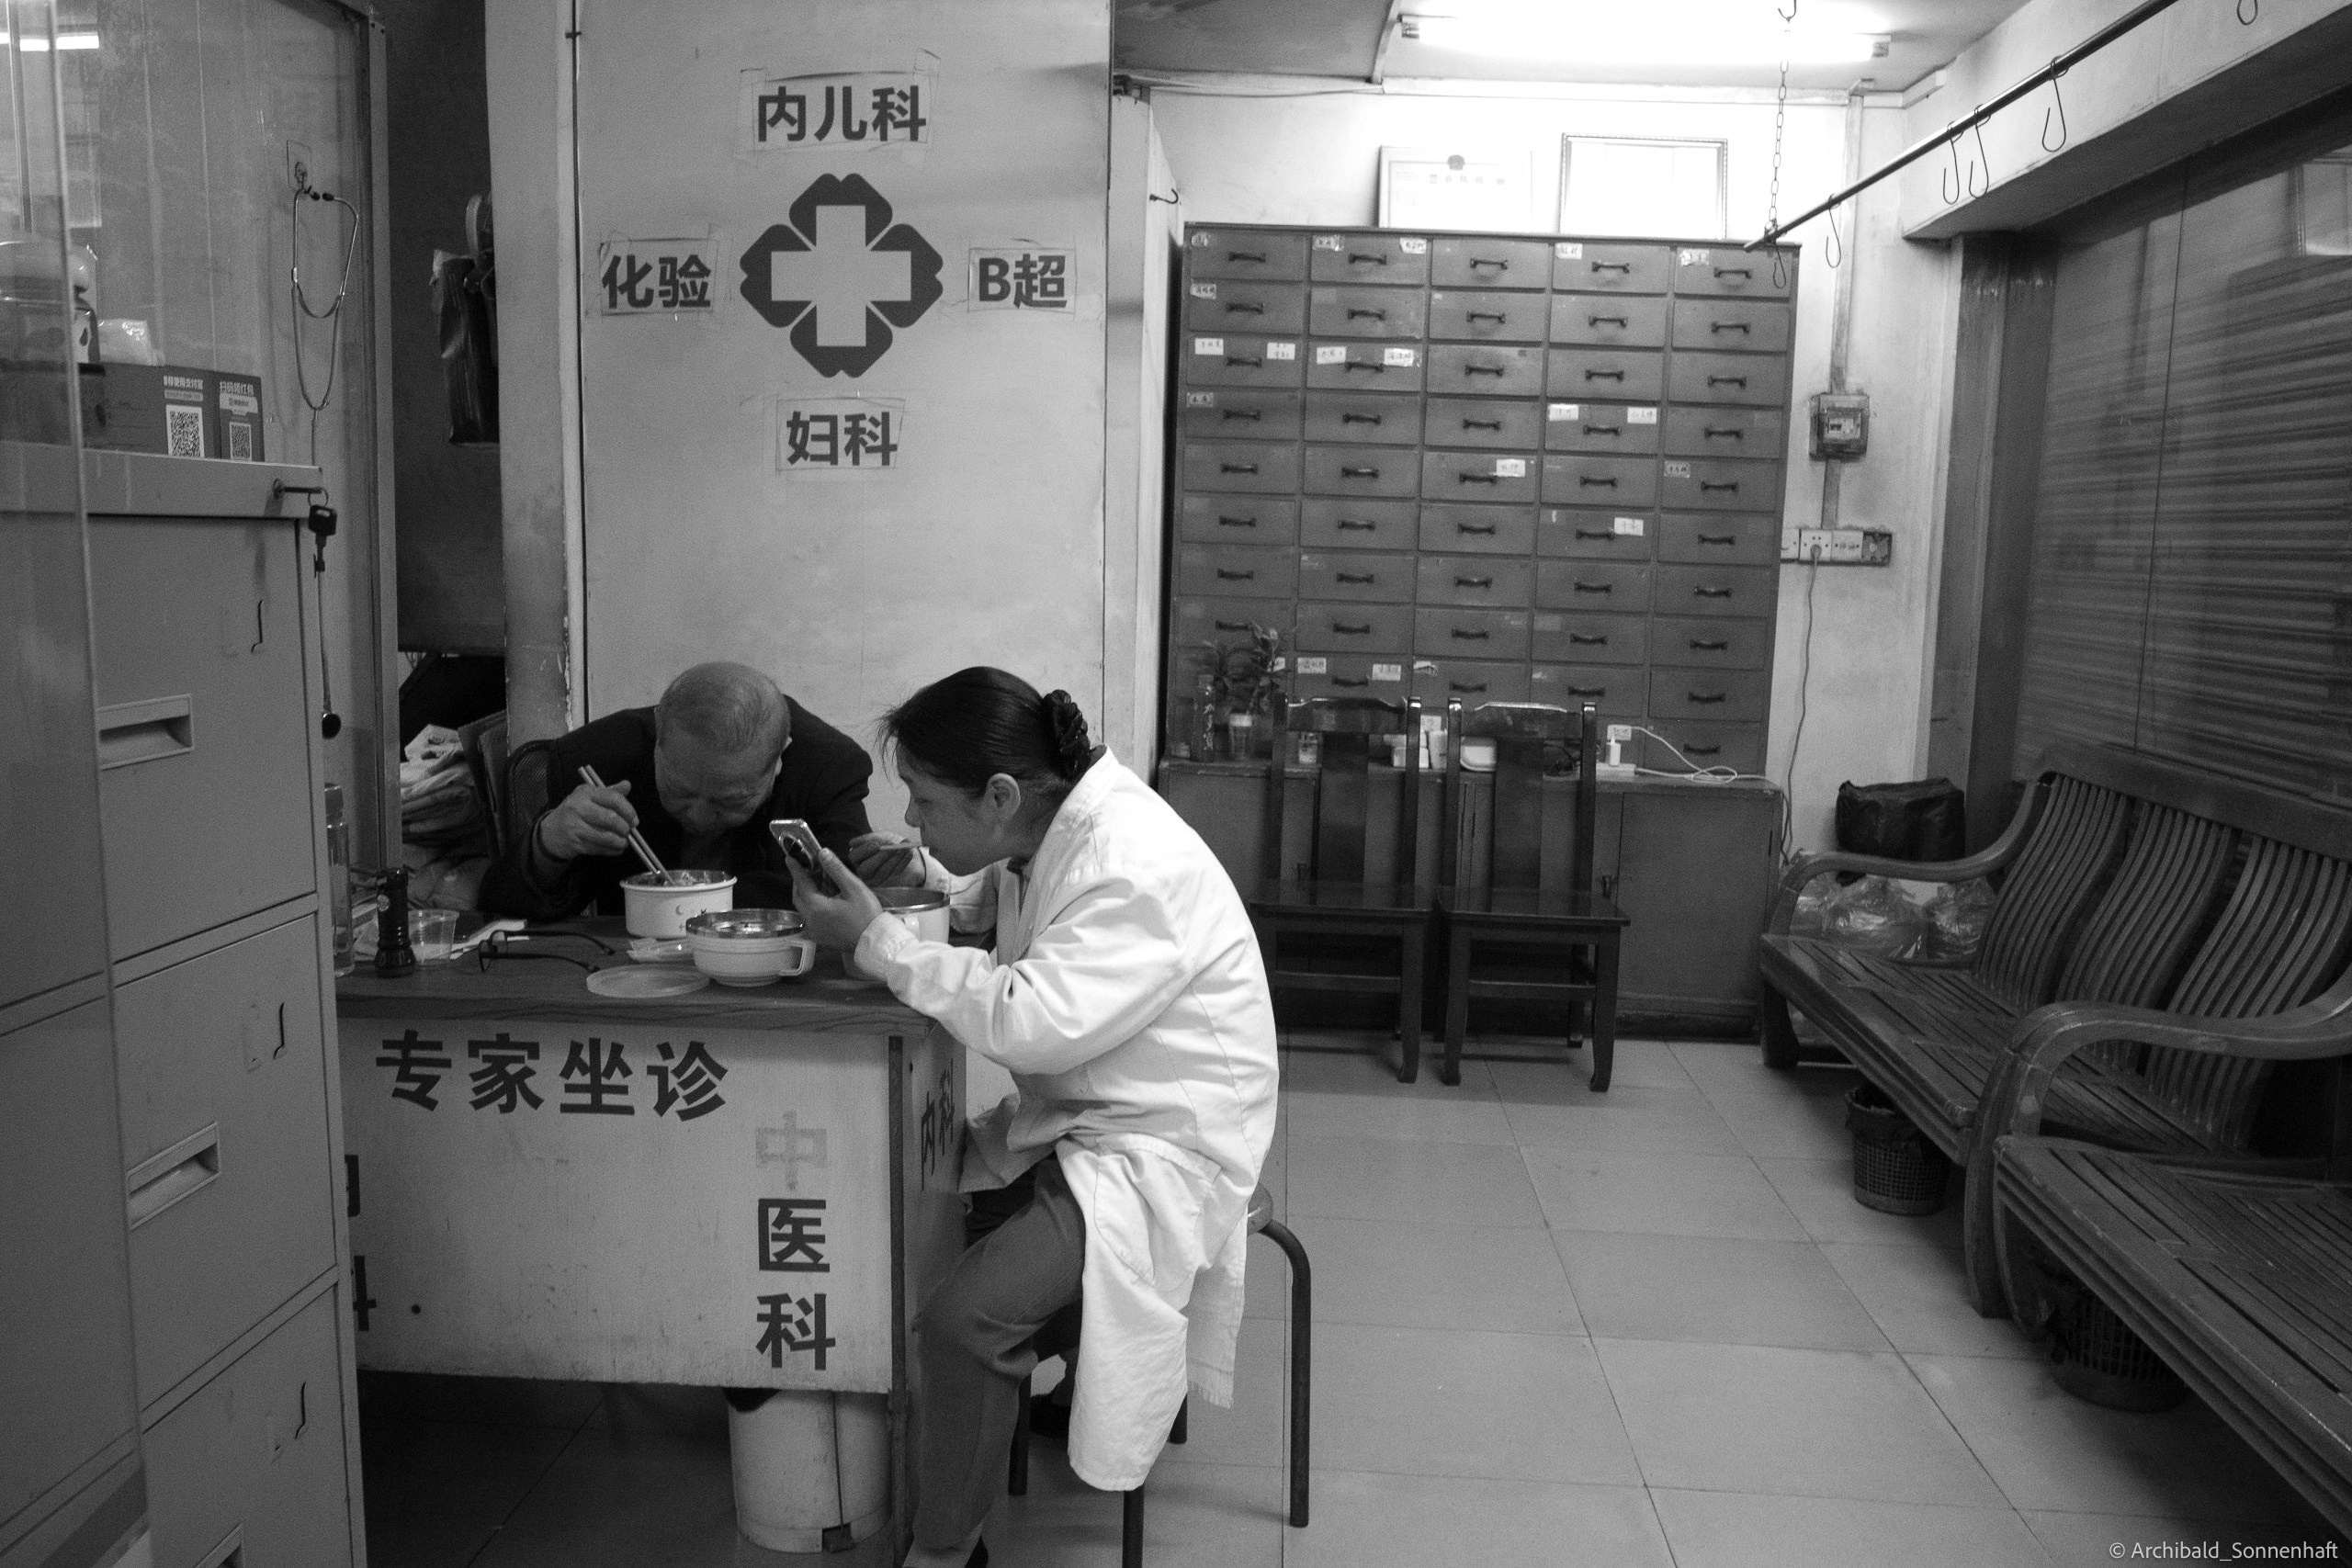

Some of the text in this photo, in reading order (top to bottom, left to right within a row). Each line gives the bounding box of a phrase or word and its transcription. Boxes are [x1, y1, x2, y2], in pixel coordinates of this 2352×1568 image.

[758, 85, 926, 141] 内儿科
[602, 254, 711, 309] 化验
[978, 254, 1068, 310] B超
[786, 411, 898, 467] 妇科
[375, 1029, 729, 1122] 专家坐诊
[922, 1058, 956, 1191] 内科
